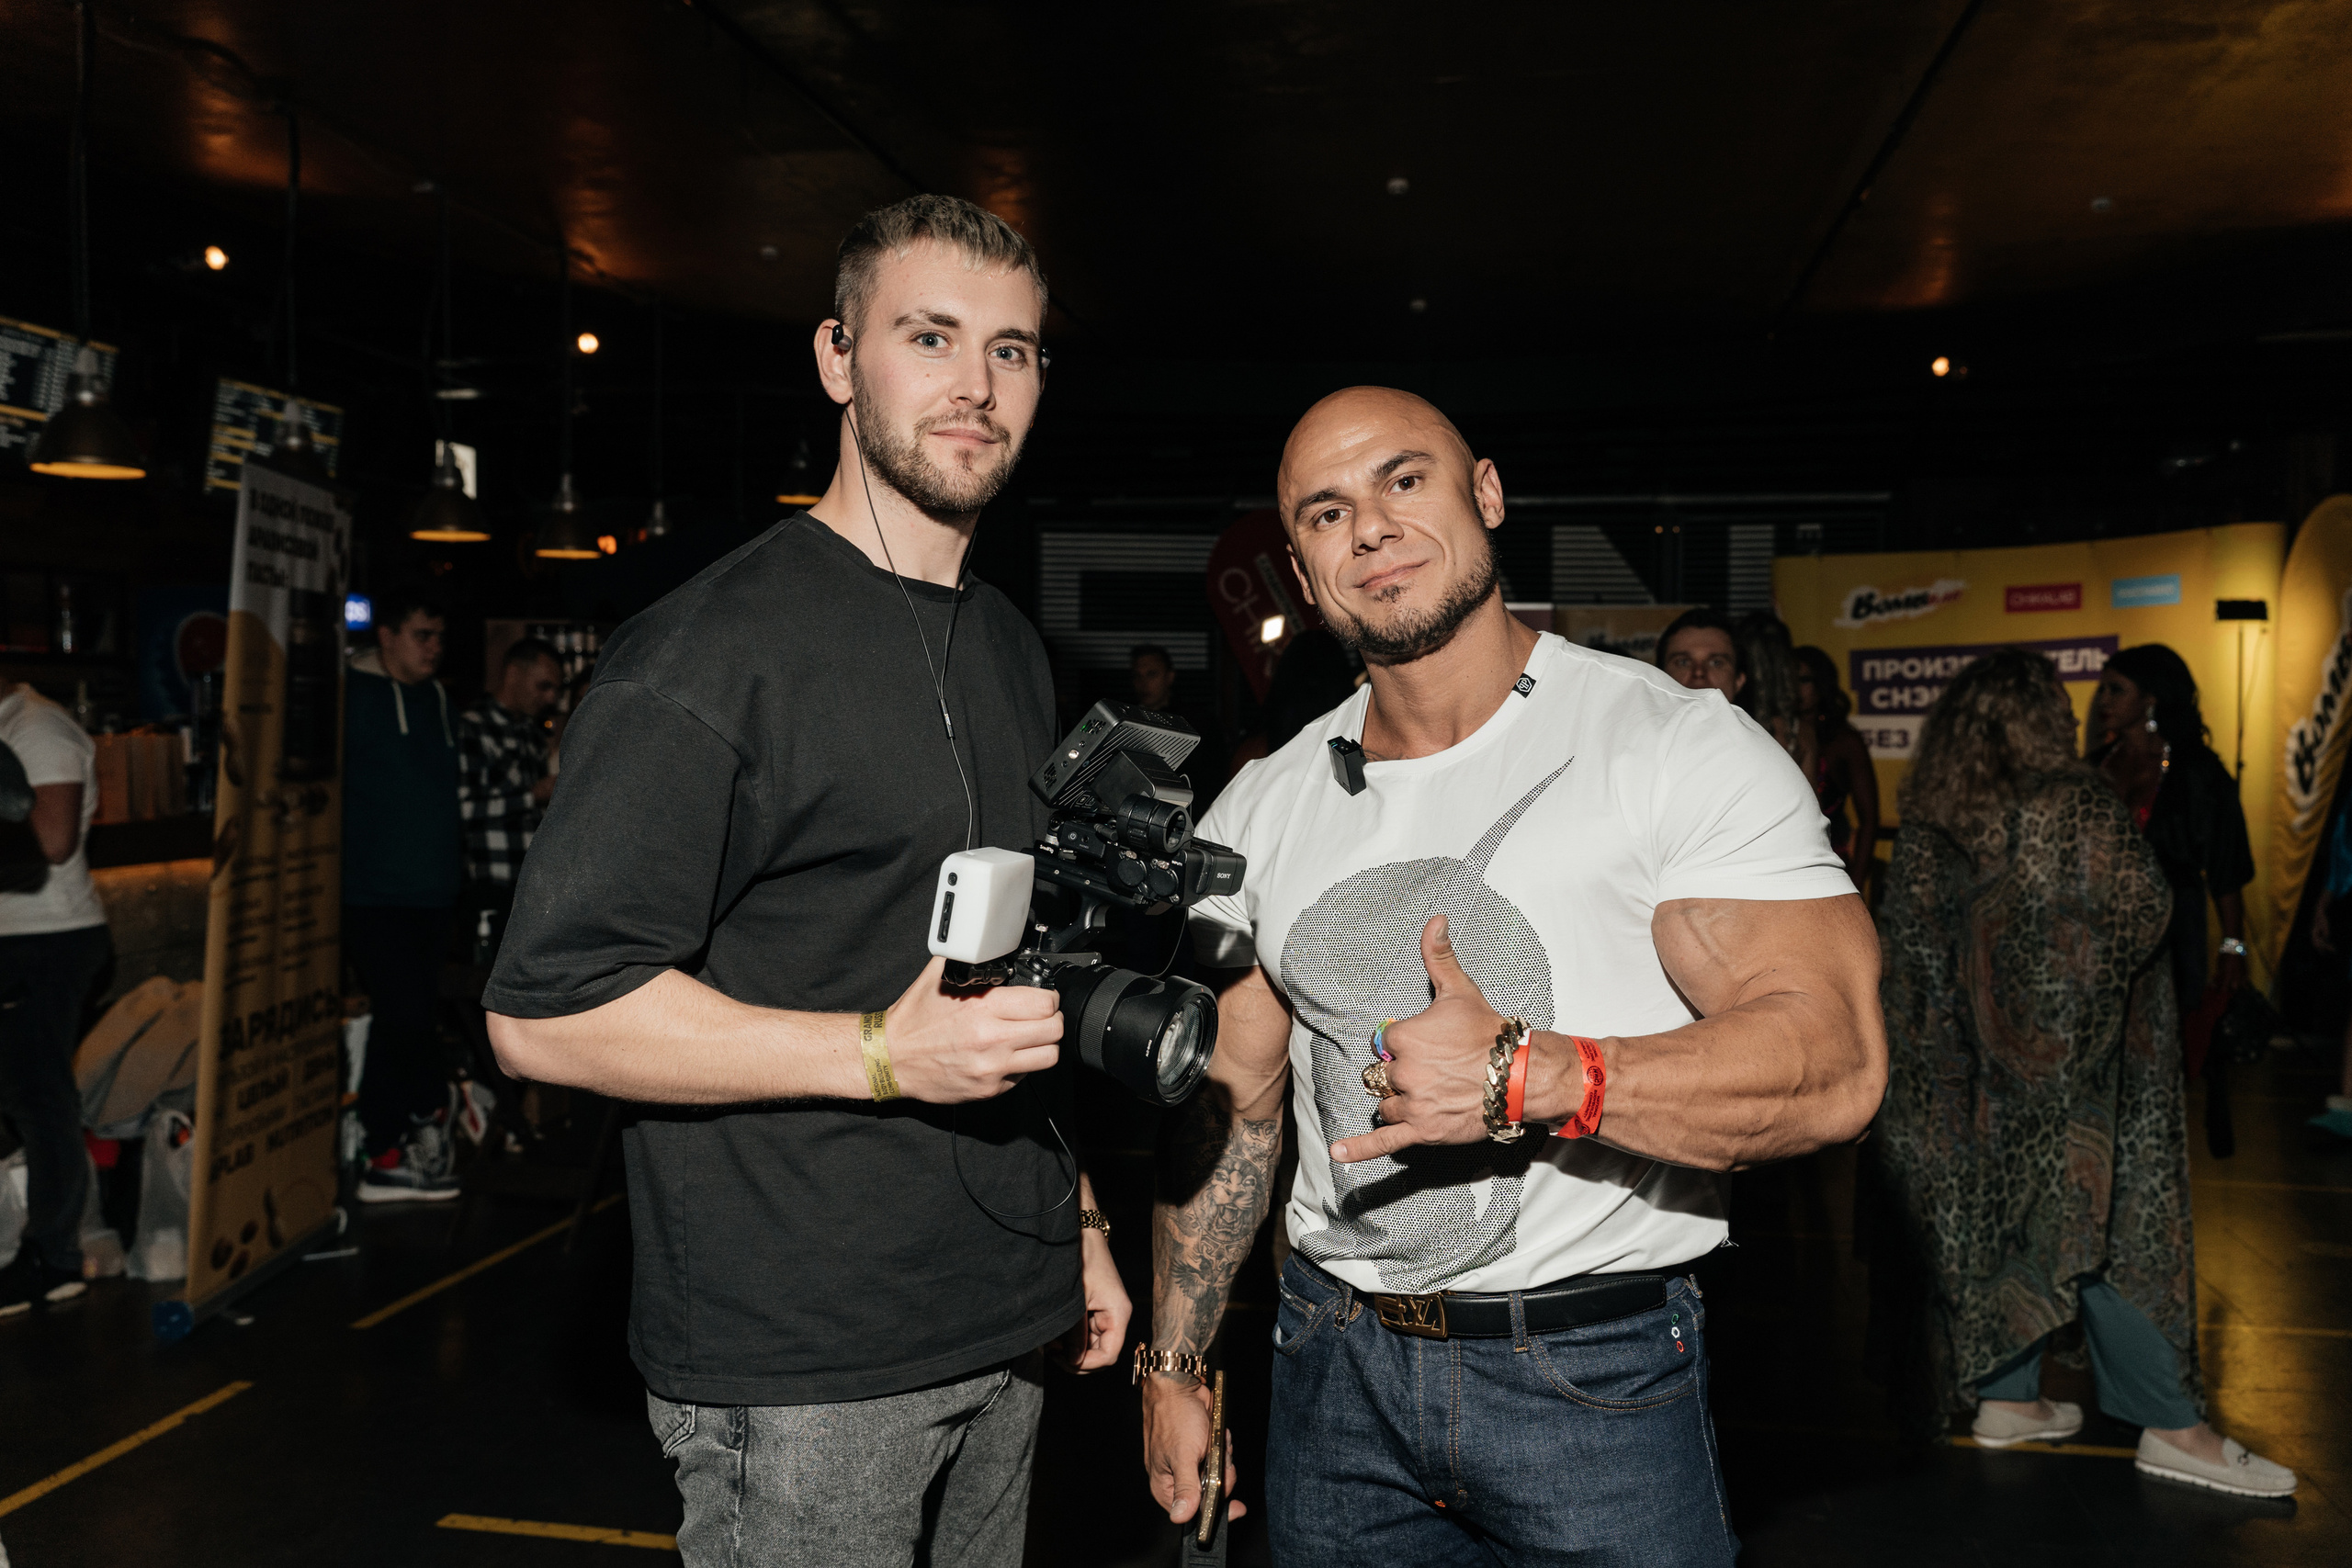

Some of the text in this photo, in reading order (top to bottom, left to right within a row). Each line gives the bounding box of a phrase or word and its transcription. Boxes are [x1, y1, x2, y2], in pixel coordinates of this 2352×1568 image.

[863, 1014, 873, 1042] GRAND
[872, 1072, 881, 1097] NATIONAL
[875, 1058, 888, 1095] BODYBUILDING
[883, 1066, 895, 1093] COMMUNITY
